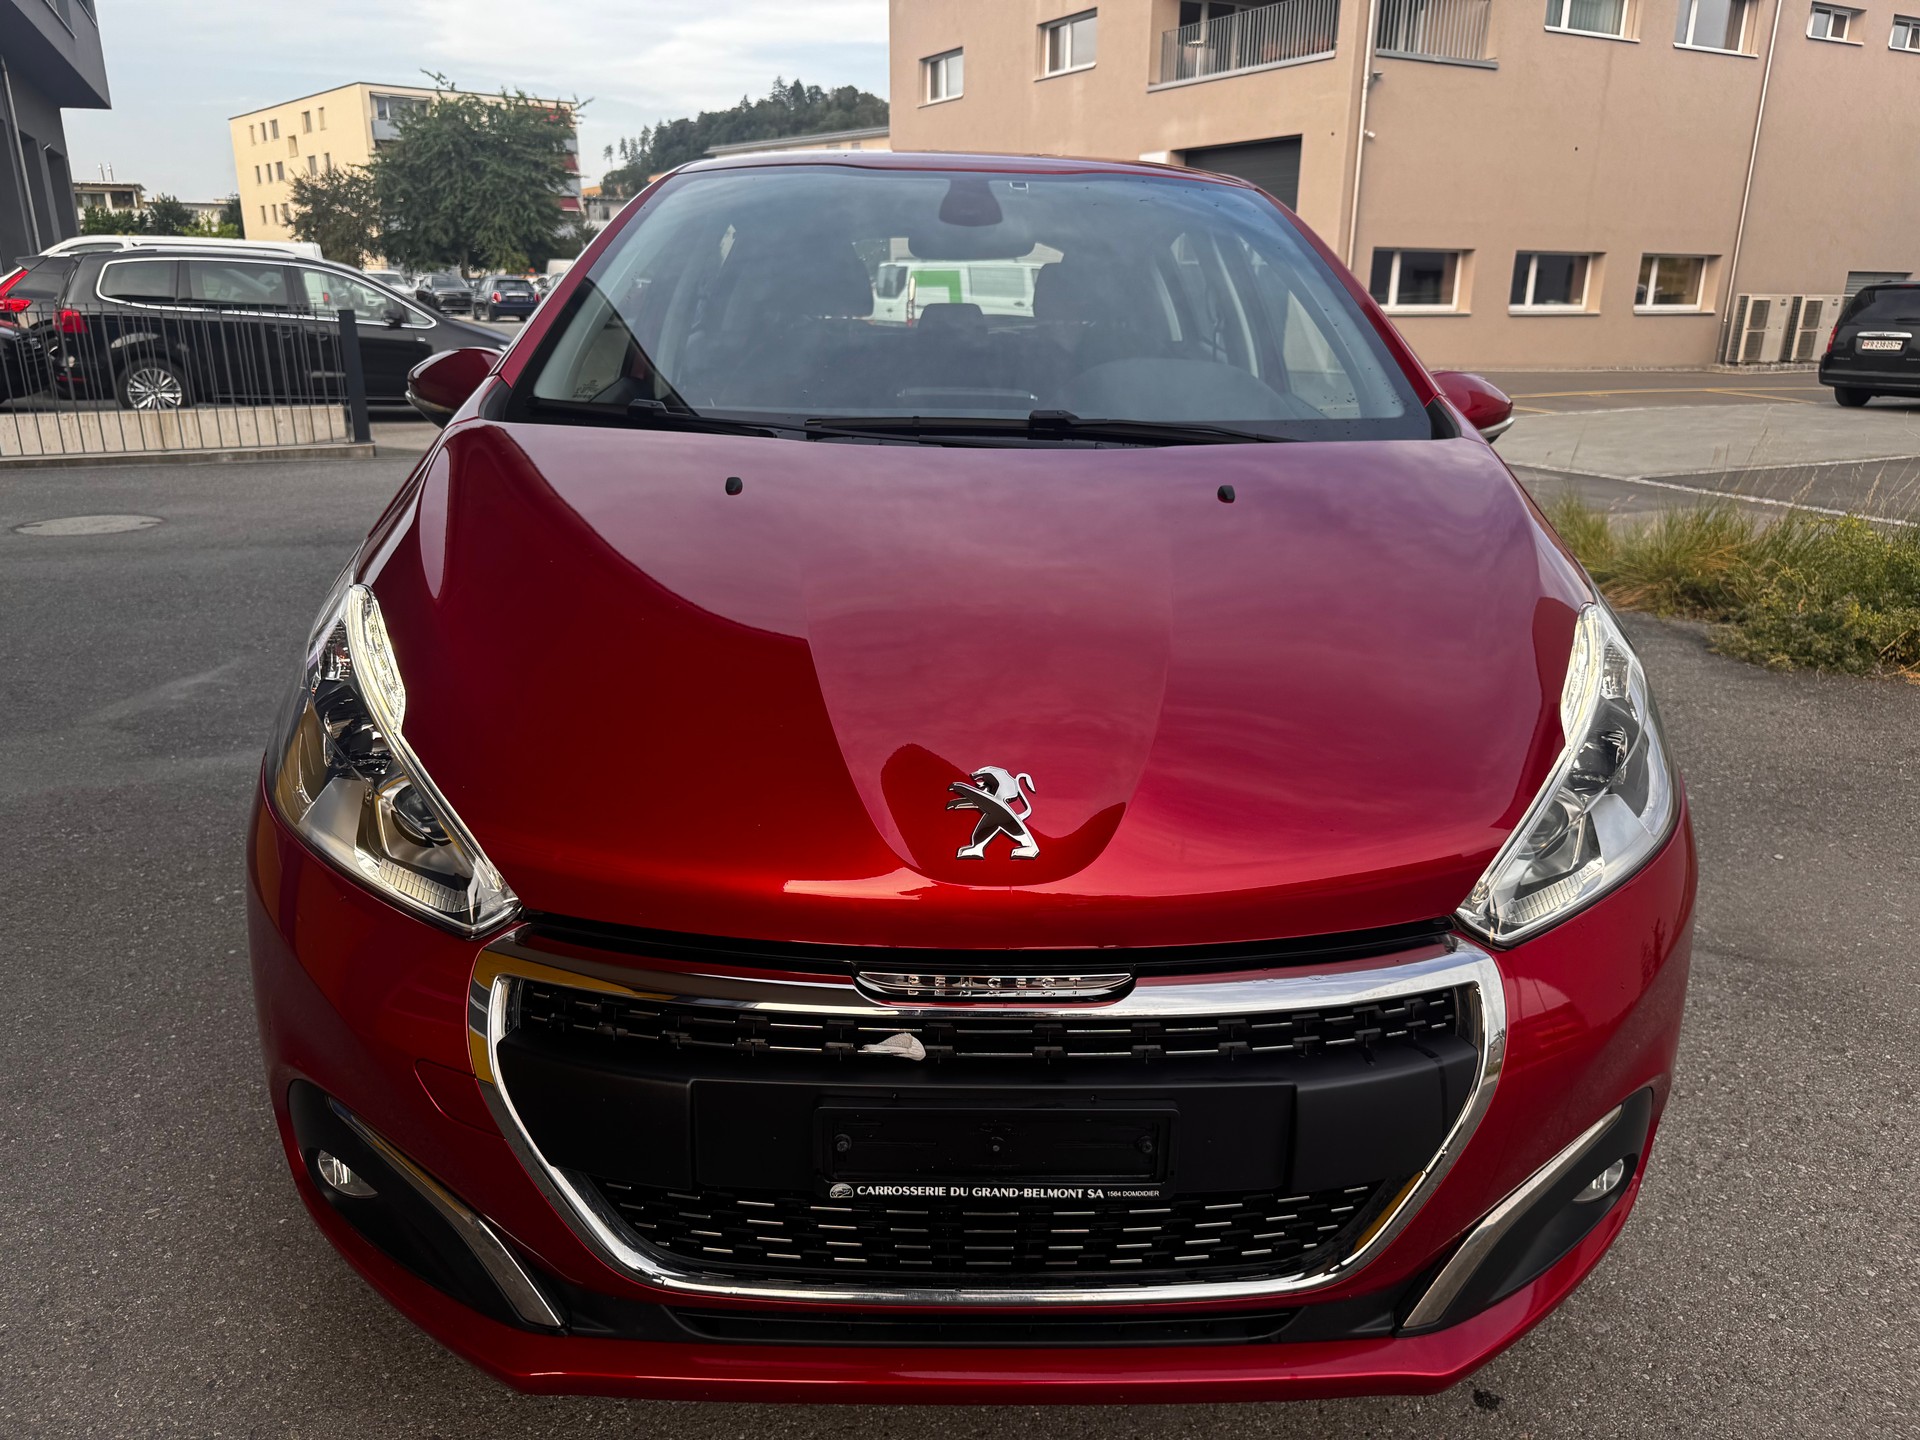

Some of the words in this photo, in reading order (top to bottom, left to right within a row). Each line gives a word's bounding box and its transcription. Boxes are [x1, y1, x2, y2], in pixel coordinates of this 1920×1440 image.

[856, 1185, 947, 1197] CARROSSERIE
[950, 1186, 969, 1197] DU
[972, 1187, 1084, 1199] GRAND-BELMONT
[1087, 1188, 1105, 1199] SA
